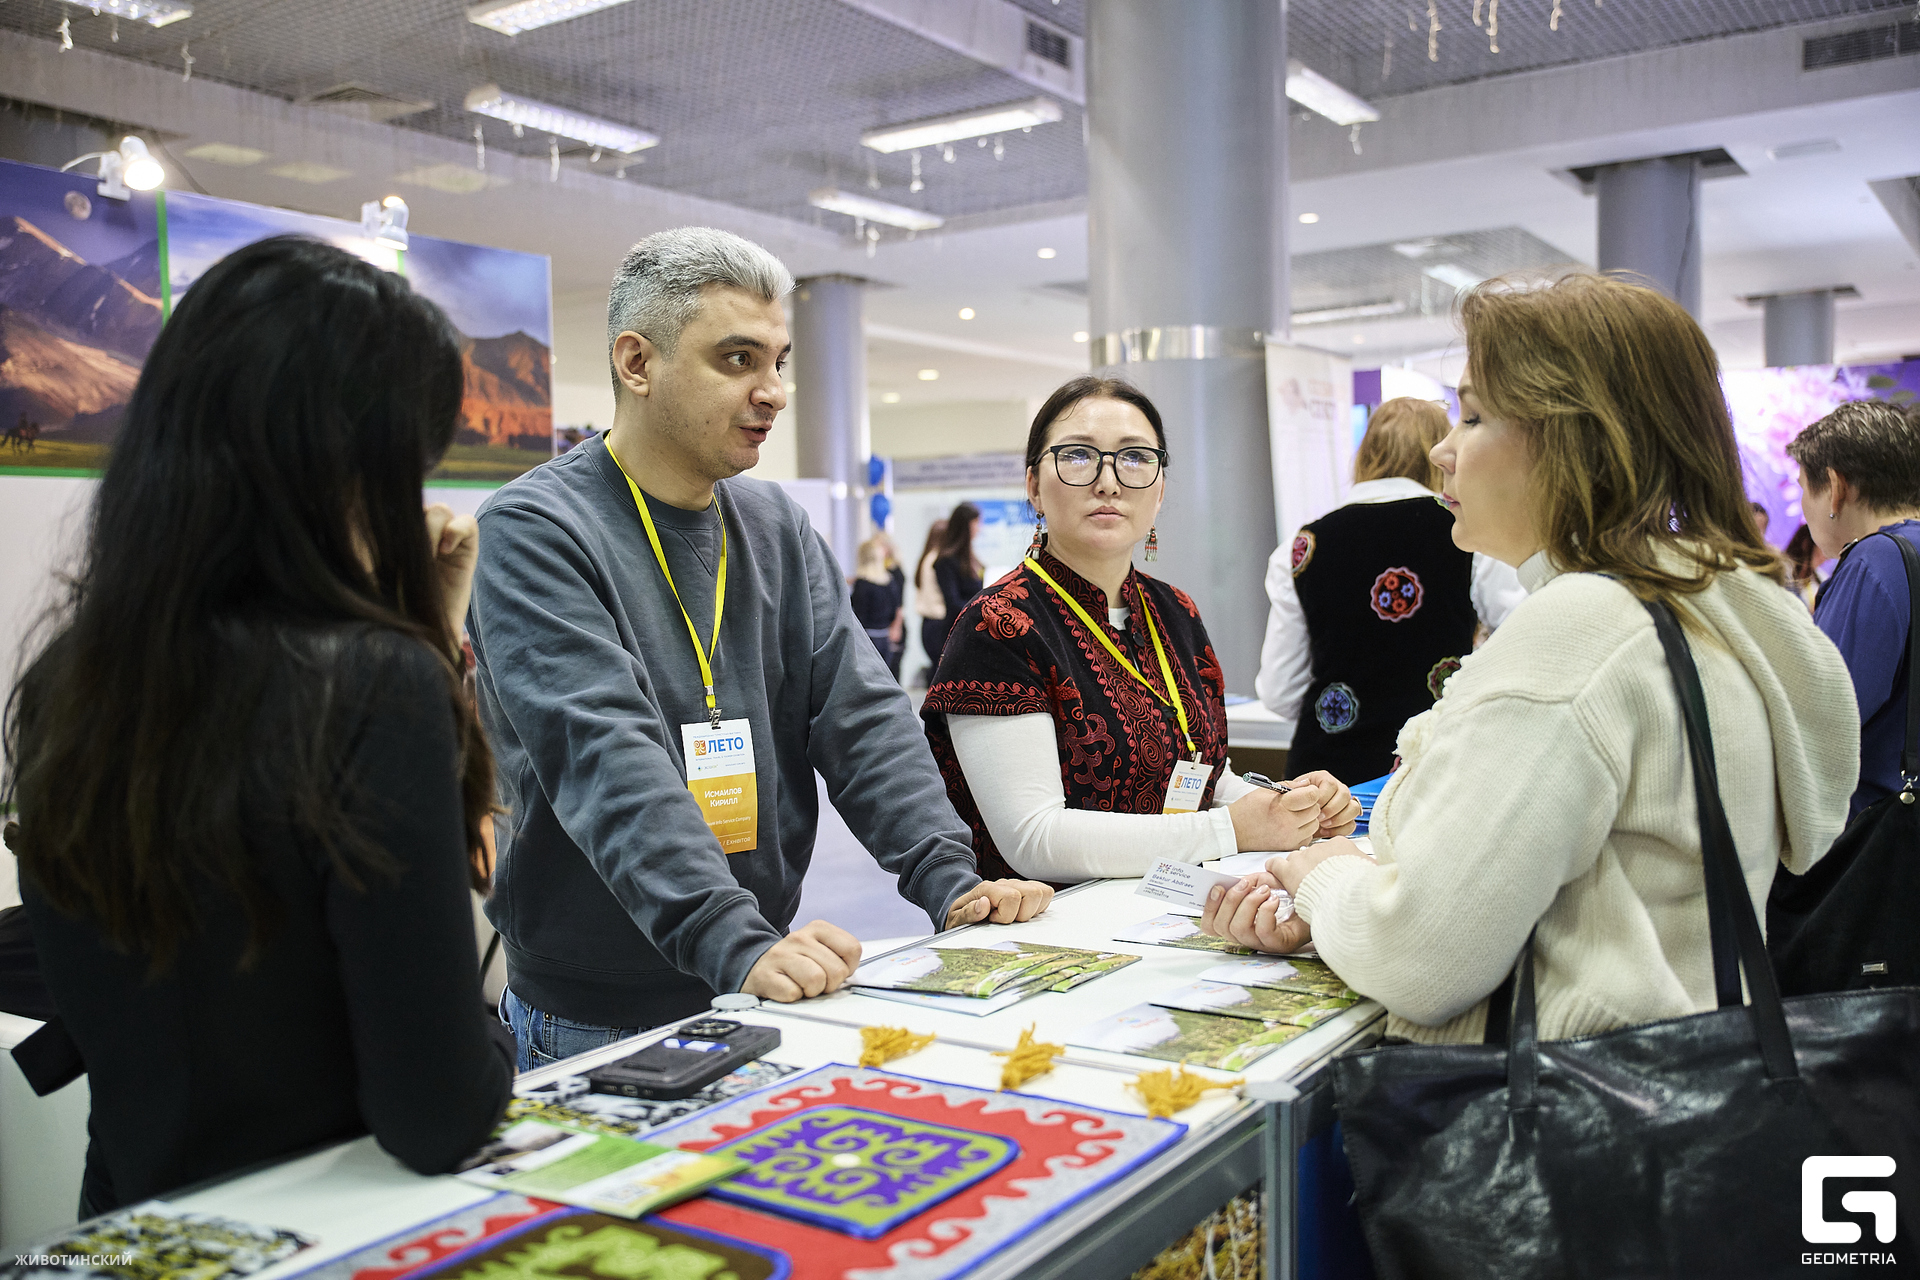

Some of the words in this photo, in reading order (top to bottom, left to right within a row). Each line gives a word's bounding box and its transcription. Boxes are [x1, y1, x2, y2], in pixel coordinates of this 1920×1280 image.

[708, 736, 744, 753] ЛЕТО
[1181, 777, 1201, 789] ЛЕТО
[1169, 871, 1191, 880] service
